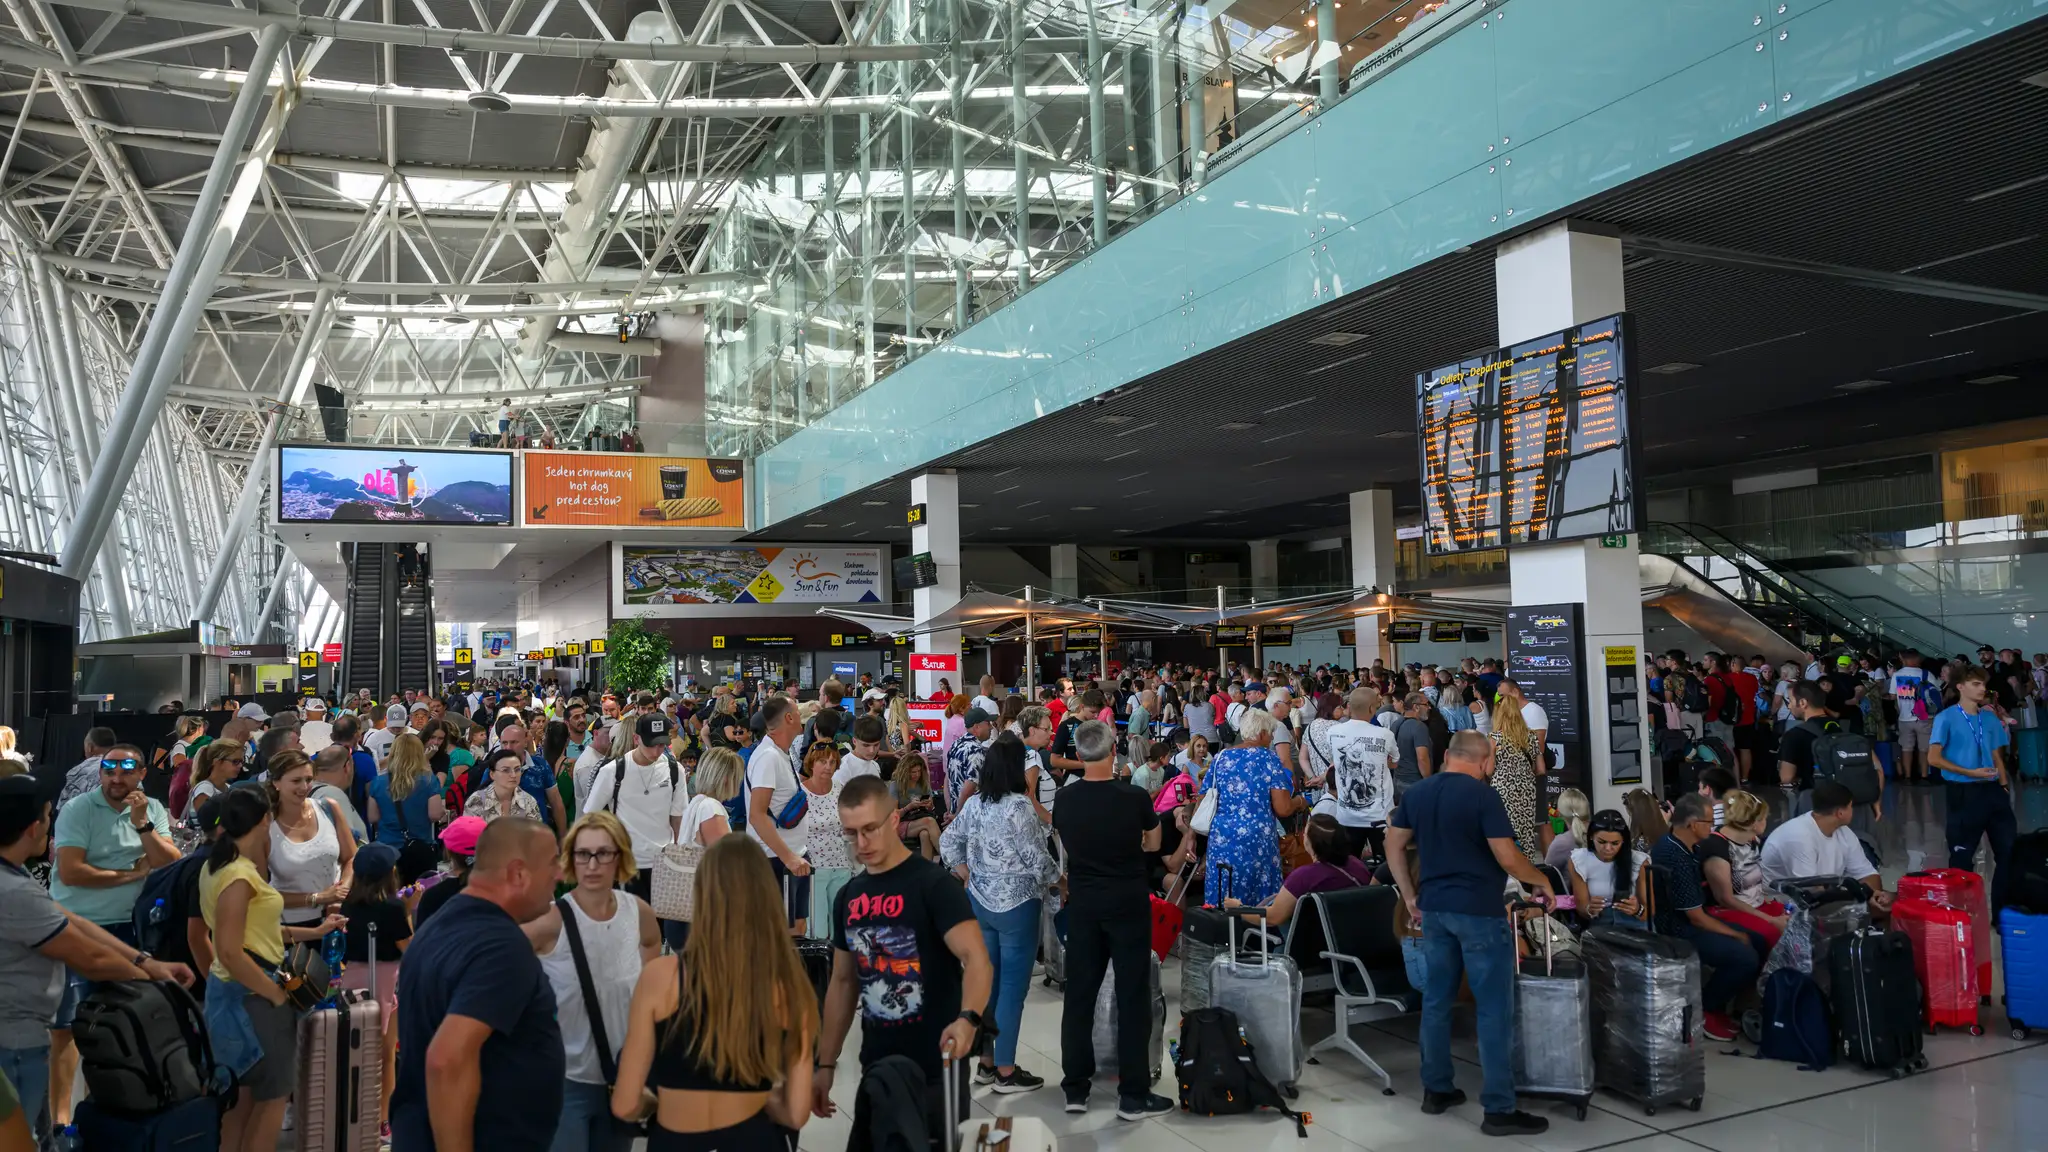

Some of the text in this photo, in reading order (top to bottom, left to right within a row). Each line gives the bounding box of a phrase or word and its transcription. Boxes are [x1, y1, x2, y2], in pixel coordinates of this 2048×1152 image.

[1470, 358, 1515, 377] Departures
[545, 466, 633, 480] Jeden chrumkavý
[569, 481, 609, 493] hot dog
[556, 496, 580, 506] pred
[794, 580, 839, 594] Sun & Fun
[925, 661, 945, 669] SATUR
[848, 892, 904, 926] DIO
